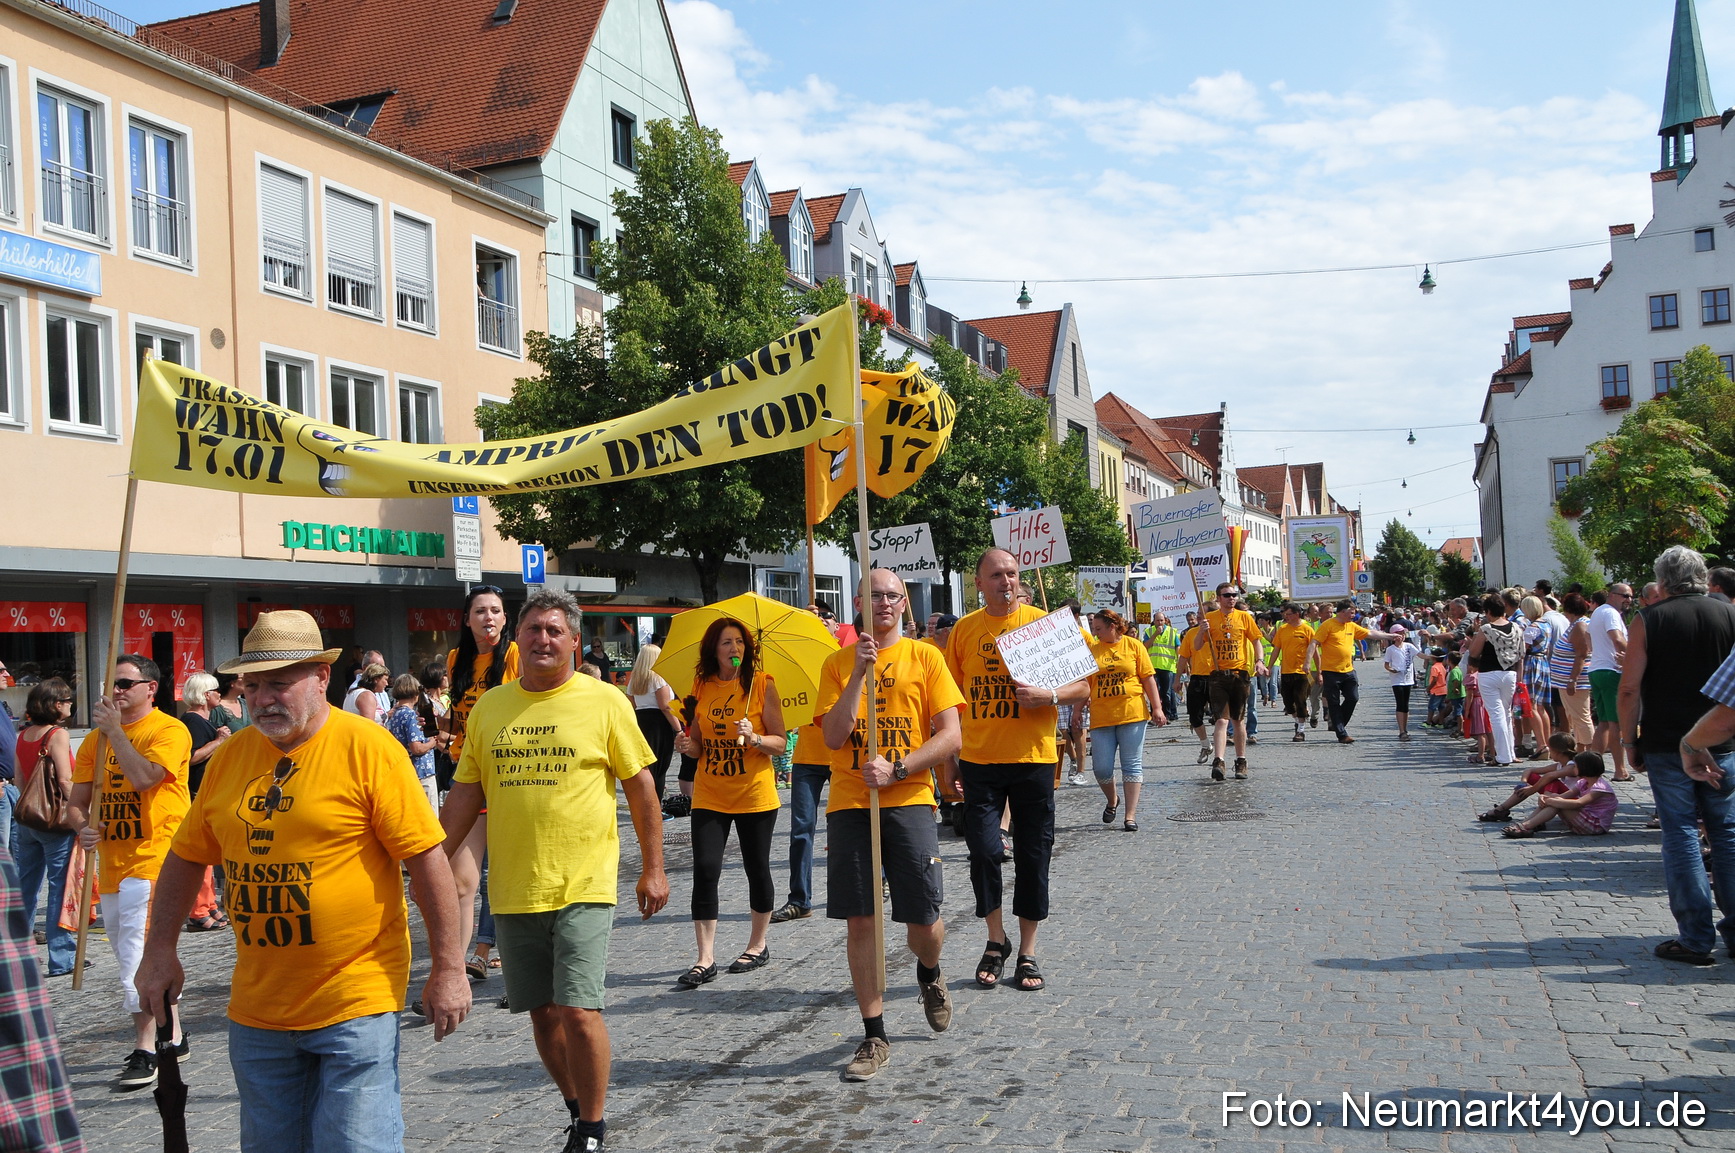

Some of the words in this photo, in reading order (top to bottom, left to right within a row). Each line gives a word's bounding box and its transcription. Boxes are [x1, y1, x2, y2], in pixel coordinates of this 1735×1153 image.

[180, 377, 292, 417] TRASS
[175, 398, 290, 443] WAHN
[515, 465, 601, 490] REGION
[602, 420, 703, 477] DEN
[718, 384, 832, 448] TOD!
[174, 431, 285, 484] 17.01
[1009, 513, 1051, 543] Hilfe
[1139, 502, 1215, 529] Bauernopfer
[869, 527, 923, 553] Stoppt
[1149, 526, 1224, 555] Nordbayern
[526, 549, 540, 579] P
[996, 617, 1057, 653] TRASSENWAHN
[1004, 650, 1024, 666] WIR
[1026, 641, 1041, 658] sind
[1042, 637, 1056, 650] das
[1054, 622, 1081, 642] VOLK!
[1010, 664, 1026, 679] WIR
[1026, 658, 1041, 672] sind
[1041, 654, 1050, 665] die
[1217, 652, 1239, 660] 17.01
[1024, 669, 1042, 684] WIR
[1042, 661, 1058, 678] sind
[1058, 656, 1071, 670] die
[1097, 685, 1127, 698] 17.01
[971, 701, 1020, 719] 17.01
[511, 725, 558, 735] STOPPT
[491, 747, 577, 759] TRASSENWAHN
[496, 764, 523, 775] 17.01
[536, 762, 568, 773] 14.01
[704, 759, 747, 776] 17.01
[499, 778, 559, 788] STÖCKELSBERG
